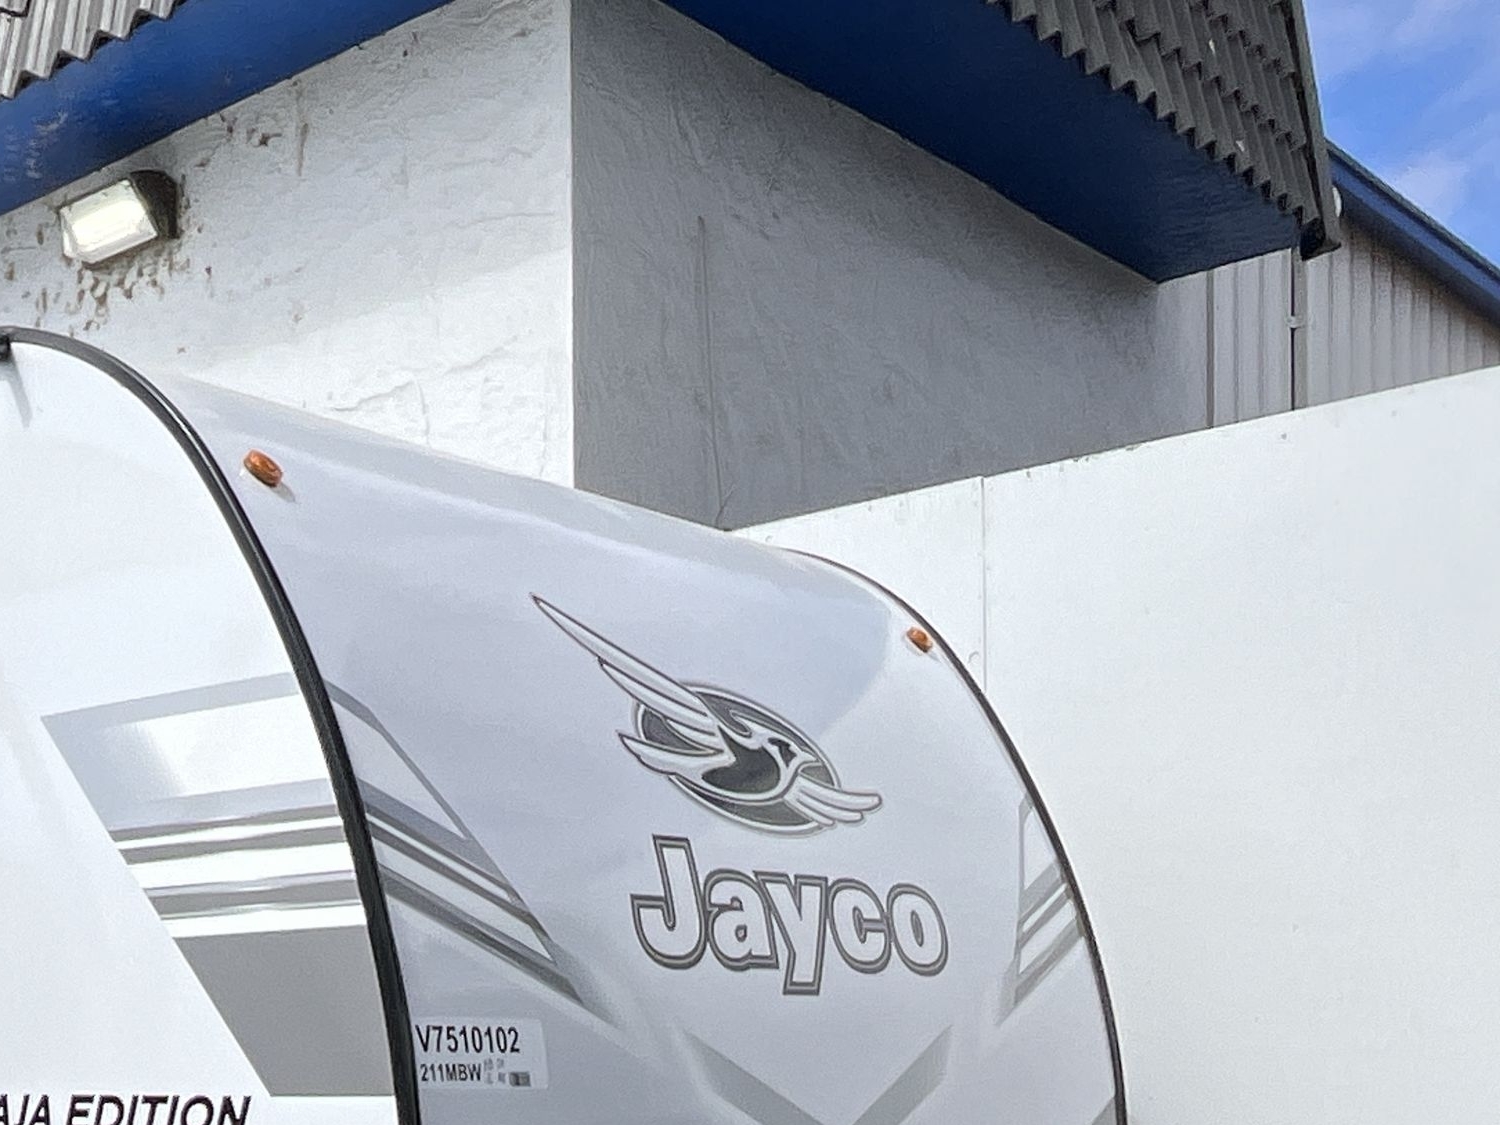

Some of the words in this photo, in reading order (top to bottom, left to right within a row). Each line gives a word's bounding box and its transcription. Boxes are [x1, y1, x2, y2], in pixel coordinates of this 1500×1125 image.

[630, 833, 949, 996] Jayco
[415, 1025, 521, 1053] V7510102
[420, 1063, 482, 1082] 211MBW
